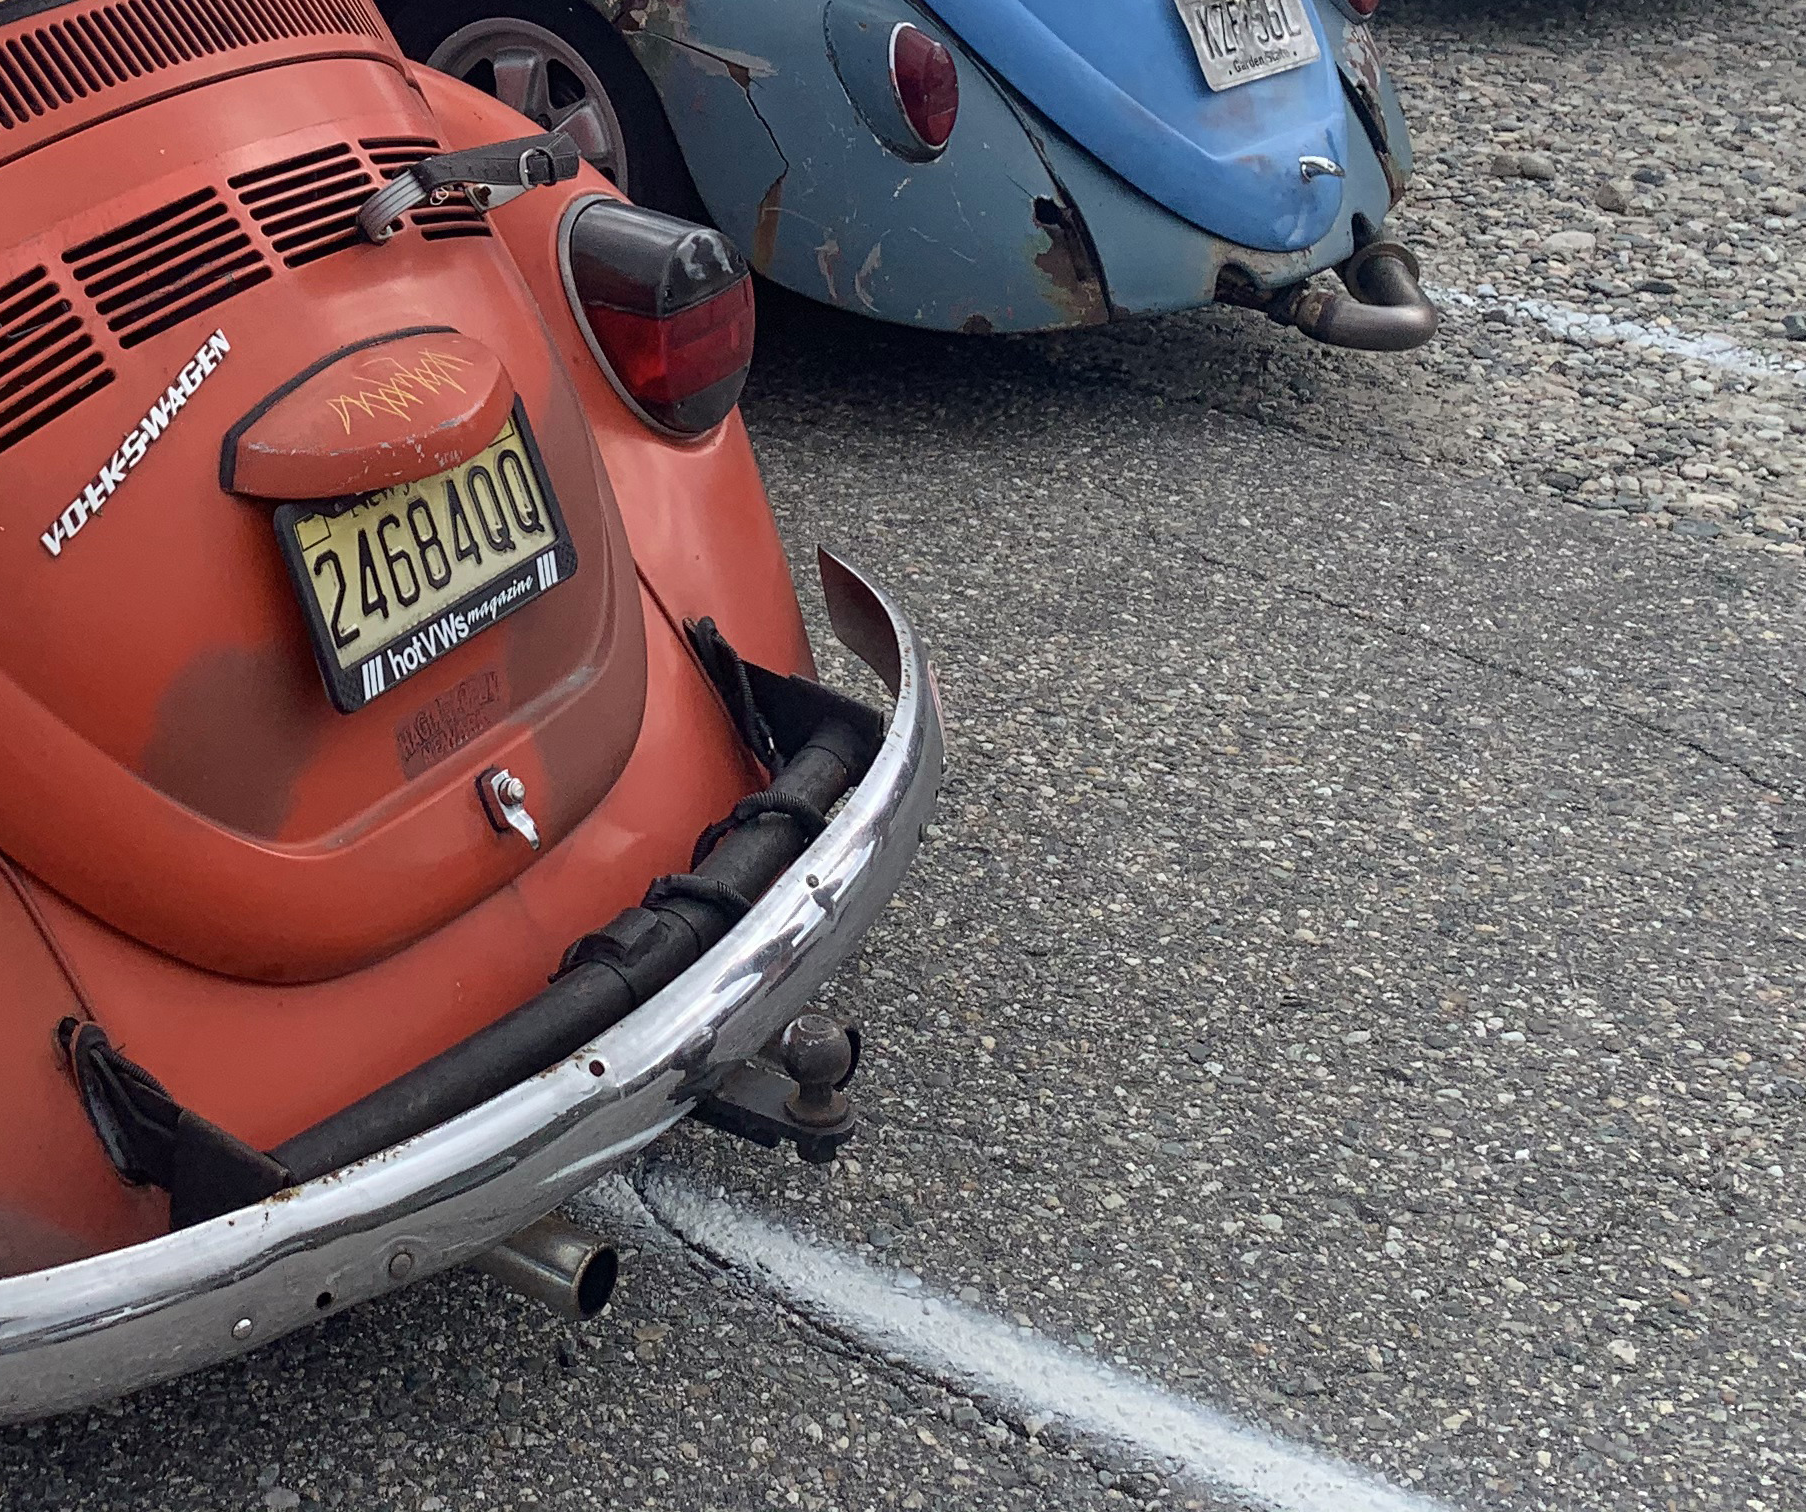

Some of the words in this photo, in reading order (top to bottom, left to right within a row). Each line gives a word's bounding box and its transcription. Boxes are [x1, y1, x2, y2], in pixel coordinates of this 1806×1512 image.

[1233, 55, 1265, 73] Garden
[40, 328, 231, 557] VOLKSWAGEN
[314, 448, 545, 650] 24684QQ
[467, 575, 534, 624] magazine
